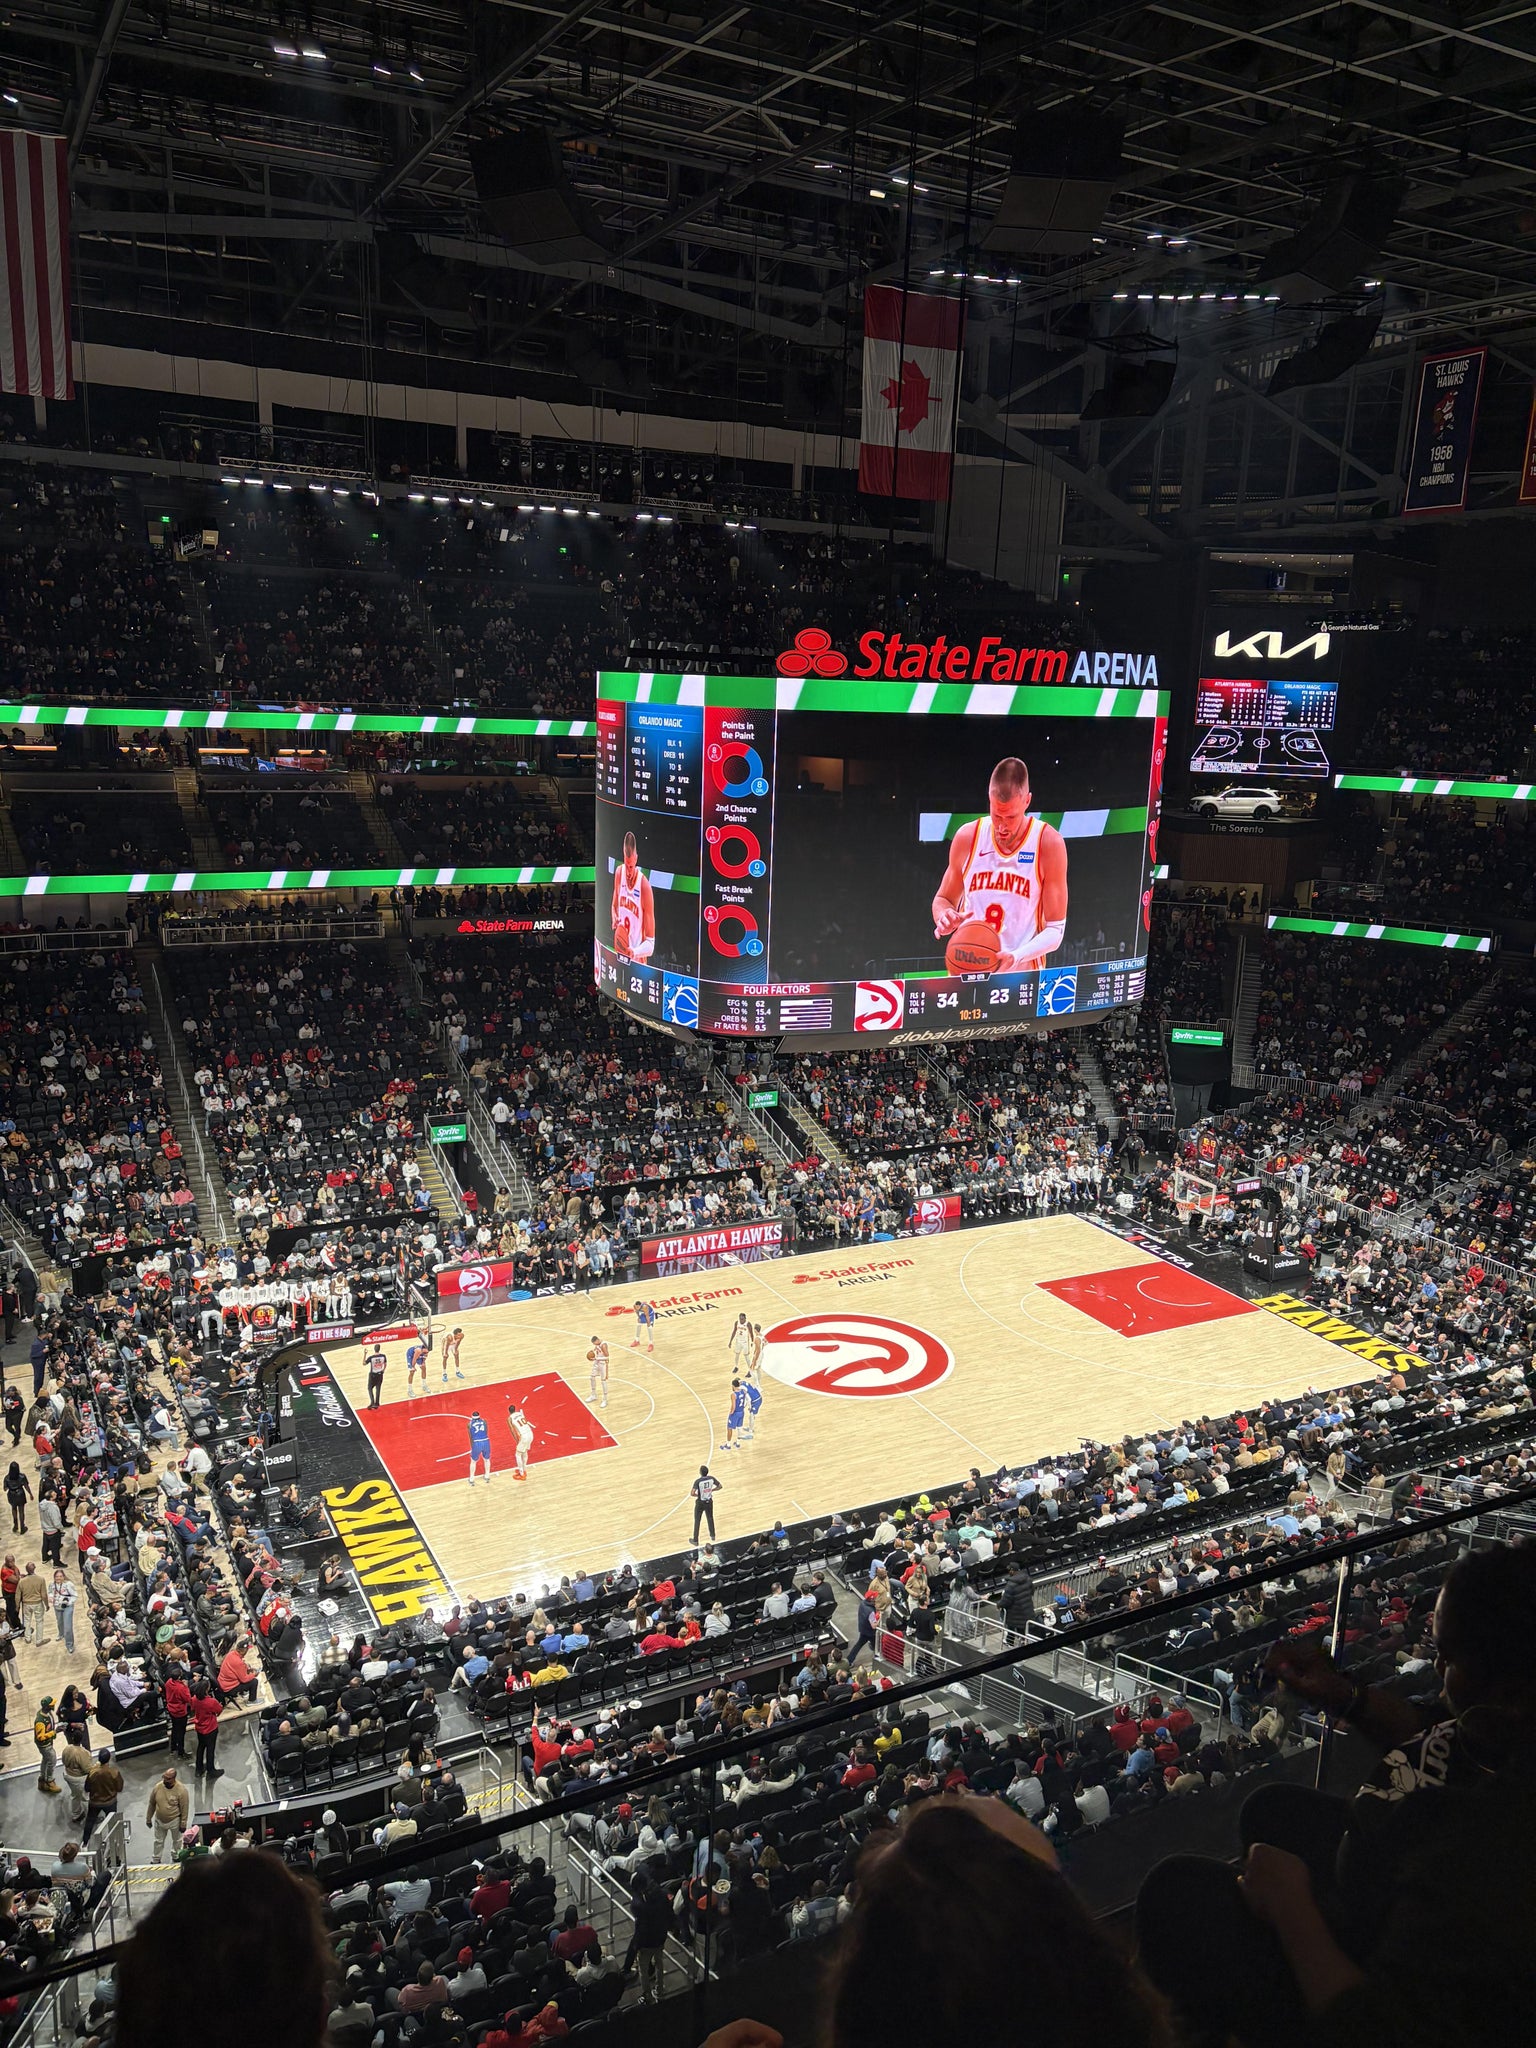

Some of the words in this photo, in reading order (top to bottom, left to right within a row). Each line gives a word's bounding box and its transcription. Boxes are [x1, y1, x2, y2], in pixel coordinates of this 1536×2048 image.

[1435, 363, 1447, 376] ST.
[1447, 360, 1470, 374] LOUIS
[1436, 373, 1465, 388] HAWKS
[1430, 444, 1454, 462] 1958
[1432, 461, 1445, 473] NBA
[1419, 473, 1455, 487] CHAMPIONS
[1327, 624, 1347, 632] Georgia
[1070, 650, 1158, 687] ARENA
[639, 715, 662, 728] ORLANDO
[663, 717, 683, 728] MAGIC
[722, 720, 745, 731] Points
[746, 722, 754, 731] in
[721, 730, 733, 740] the
[734, 731, 755, 741] Paint
[711, 746, 718, 754] 8
[756, 781, 762, 789] 8
[715, 803, 729, 813] 2nd
[730, 804, 757, 815] Chance
[723, 813, 747, 823] Points
[1209, 823, 1227, 832] The
[1229, 823, 1264, 834] Sorento
[754, 862, 760, 870] 0
[715, 884, 730, 894] Fast
[731, 885, 753, 895] Break
[969, 871, 1031, 899] ATLANTA
[722, 894, 745, 904] Points
[985, 903, 1005, 934] 8
[533, 920, 564, 930] ARENA
[1108, 962, 1122, 972] FOUR
[1123, 959, 1146, 970] FACTORS
[630, 976, 642, 994] 23
[743, 985, 769, 996] FOUR
[770, 984, 811, 995] FACTORS
[936, 993, 959, 1008] 34
[989, 989, 1010, 1004] 23
[727, 999, 740, 1007] EFG
[740, 999, 748, 1007] %
[755, 999, 765, 1008] 62
[909, 999, 919, 1007] TOL
[730, 1007, 740, 1015] TO
[755, 1007, 771, 1016] 15.4
[959, 1008, 982, 1021] 10:13
[720, 1014, 740, 1022] OREB
[740, 1015, 748, 1023] %
[755, 1015, 764, 1024] 32
[714, 1021, 721, 1029] FT
[721, 1022, 740, 1031] RATE
[740, 1023, 747, 1031] %
[754, 1023, 766, 1032] 9.5
[888, 1021, 1031, 1046] globalpayments
[1173, 1031, 1194, 1040] Sprite
[754, 1093, 773, 1102] Sprite
[436, 1127, 460, 1137] Sprite
[656, 1233, 728, 1259] ATLANTA
[730, 1223, 783, 1246] HAWKS
[1139, 1241, 1194, 1268] ULTRA
[1274, 1258, 1300, 1269] coinbase
[837, 1272, 897, 1287] ARENA
[654, 1302, 720, 1320] ARENA
[309, 1330, 321, 1340] GET
[322, 1328, 333, 1339] THE
[1248, 1292, 1431, 1372] HAWKS
[320, 1479, 448, 1626] HAWKS
